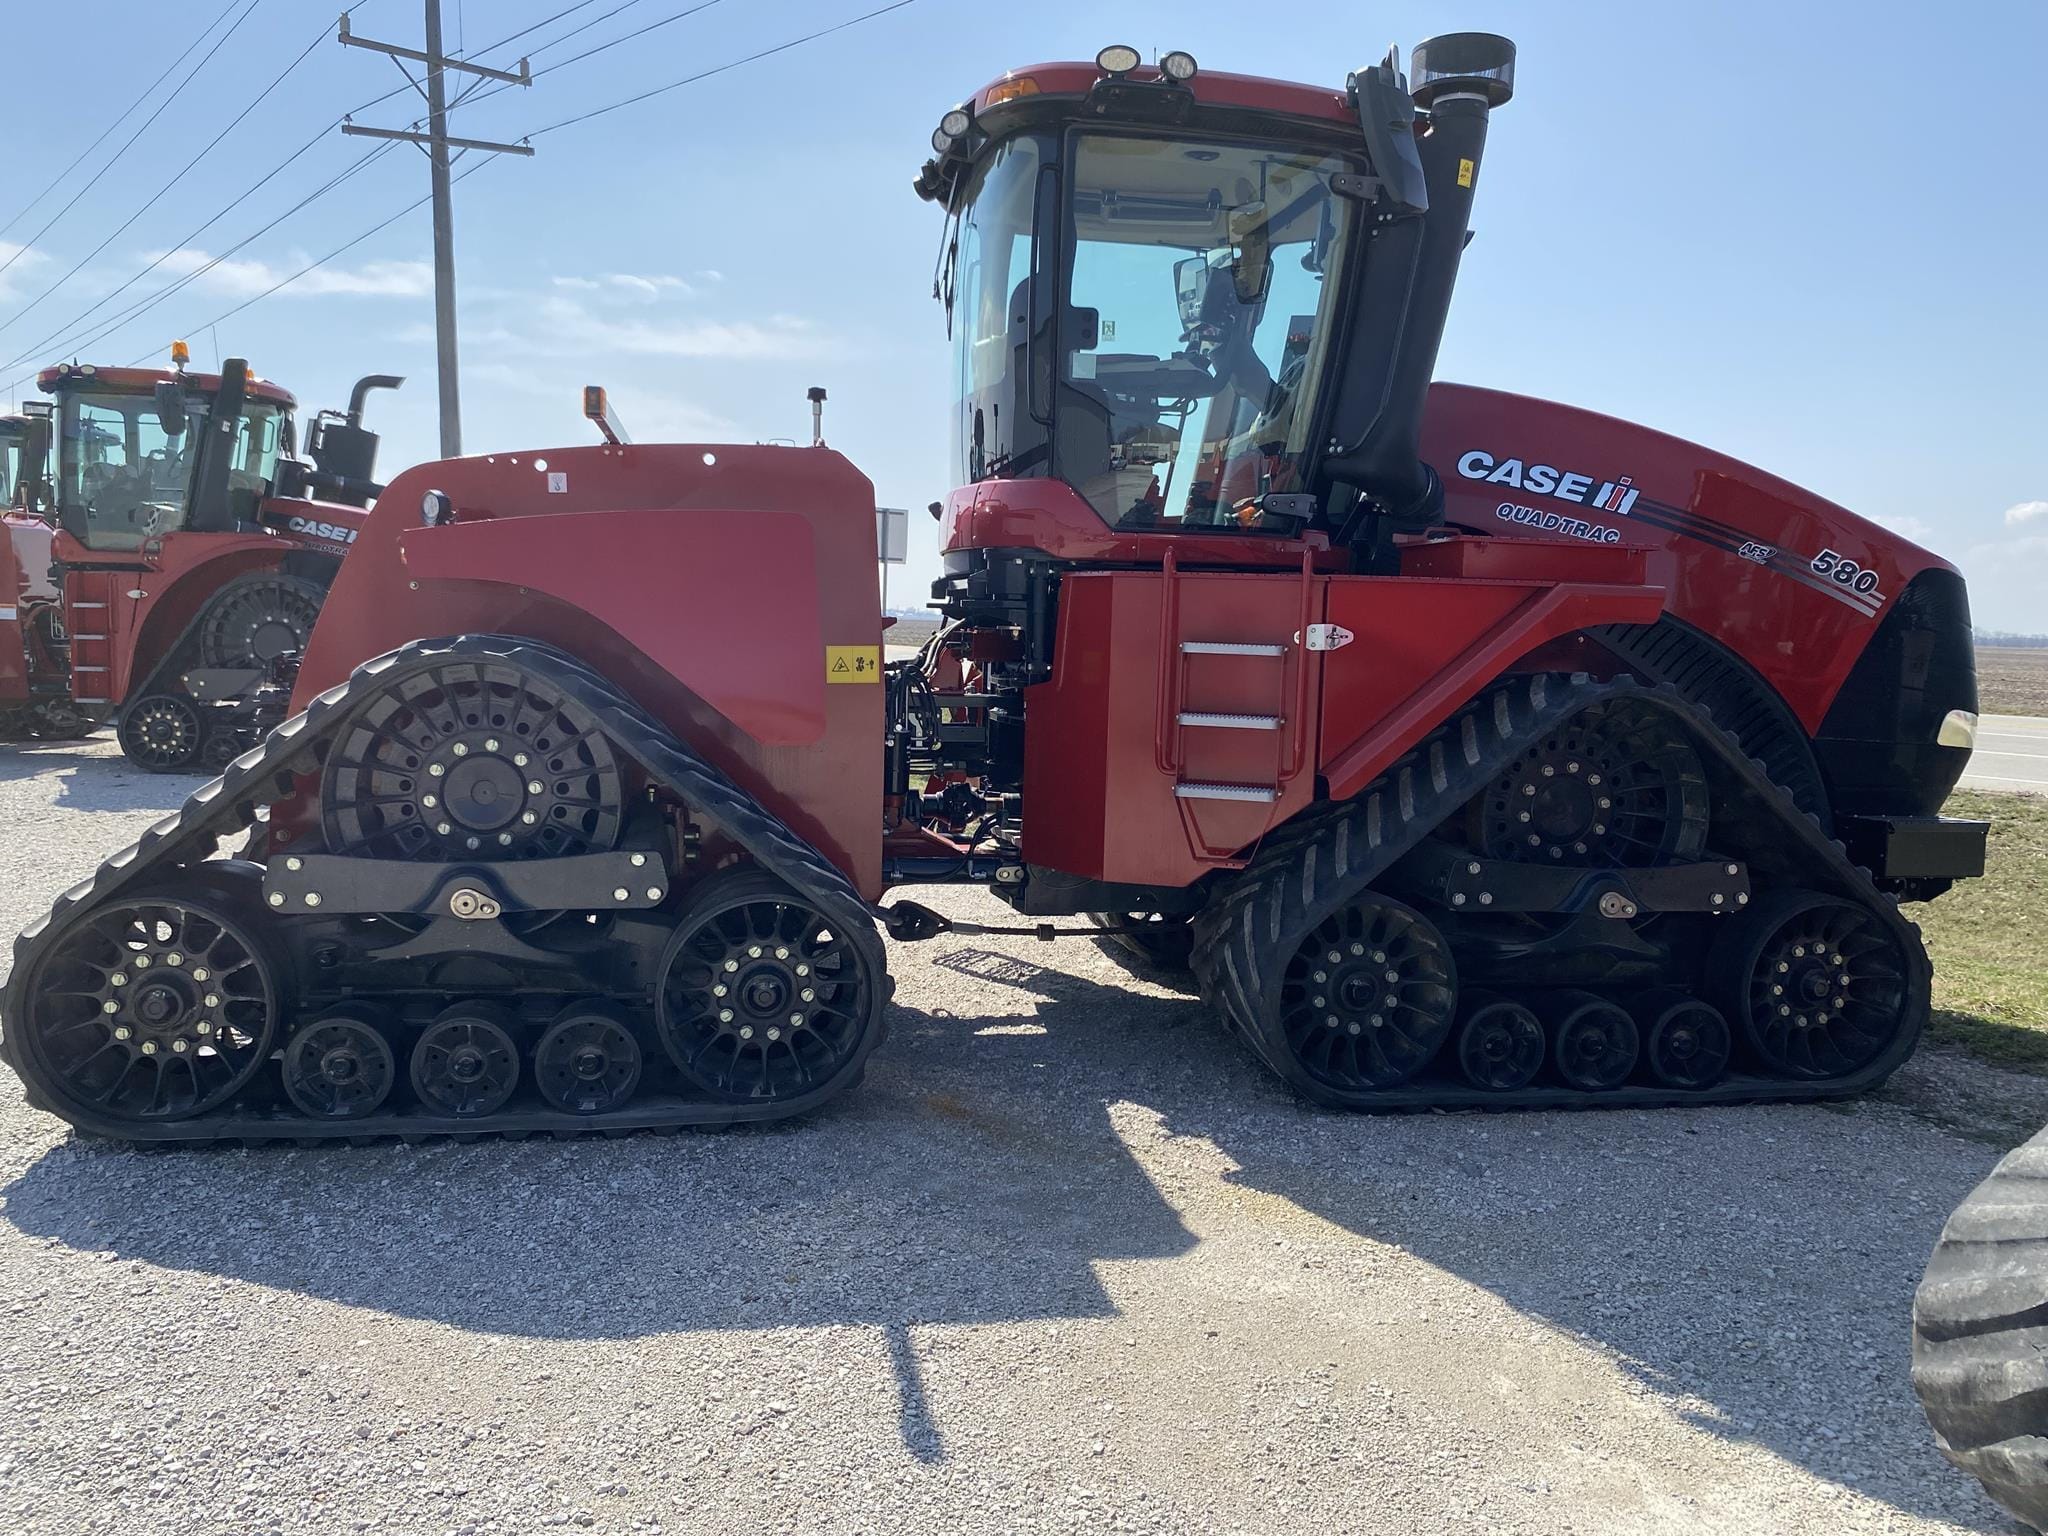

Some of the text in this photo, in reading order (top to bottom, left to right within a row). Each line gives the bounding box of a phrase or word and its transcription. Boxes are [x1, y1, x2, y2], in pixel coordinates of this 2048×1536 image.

[1457, 450, 1594, 503] CASE
[289, 517, 348, 542] CASE
[1496, 502, 1621, 544] QUADTRAC
[304, 541, 349, 556] UADTRA
[1739, 541, 1770, 559] AFS
[1811, 548, 1879, 595] 580
